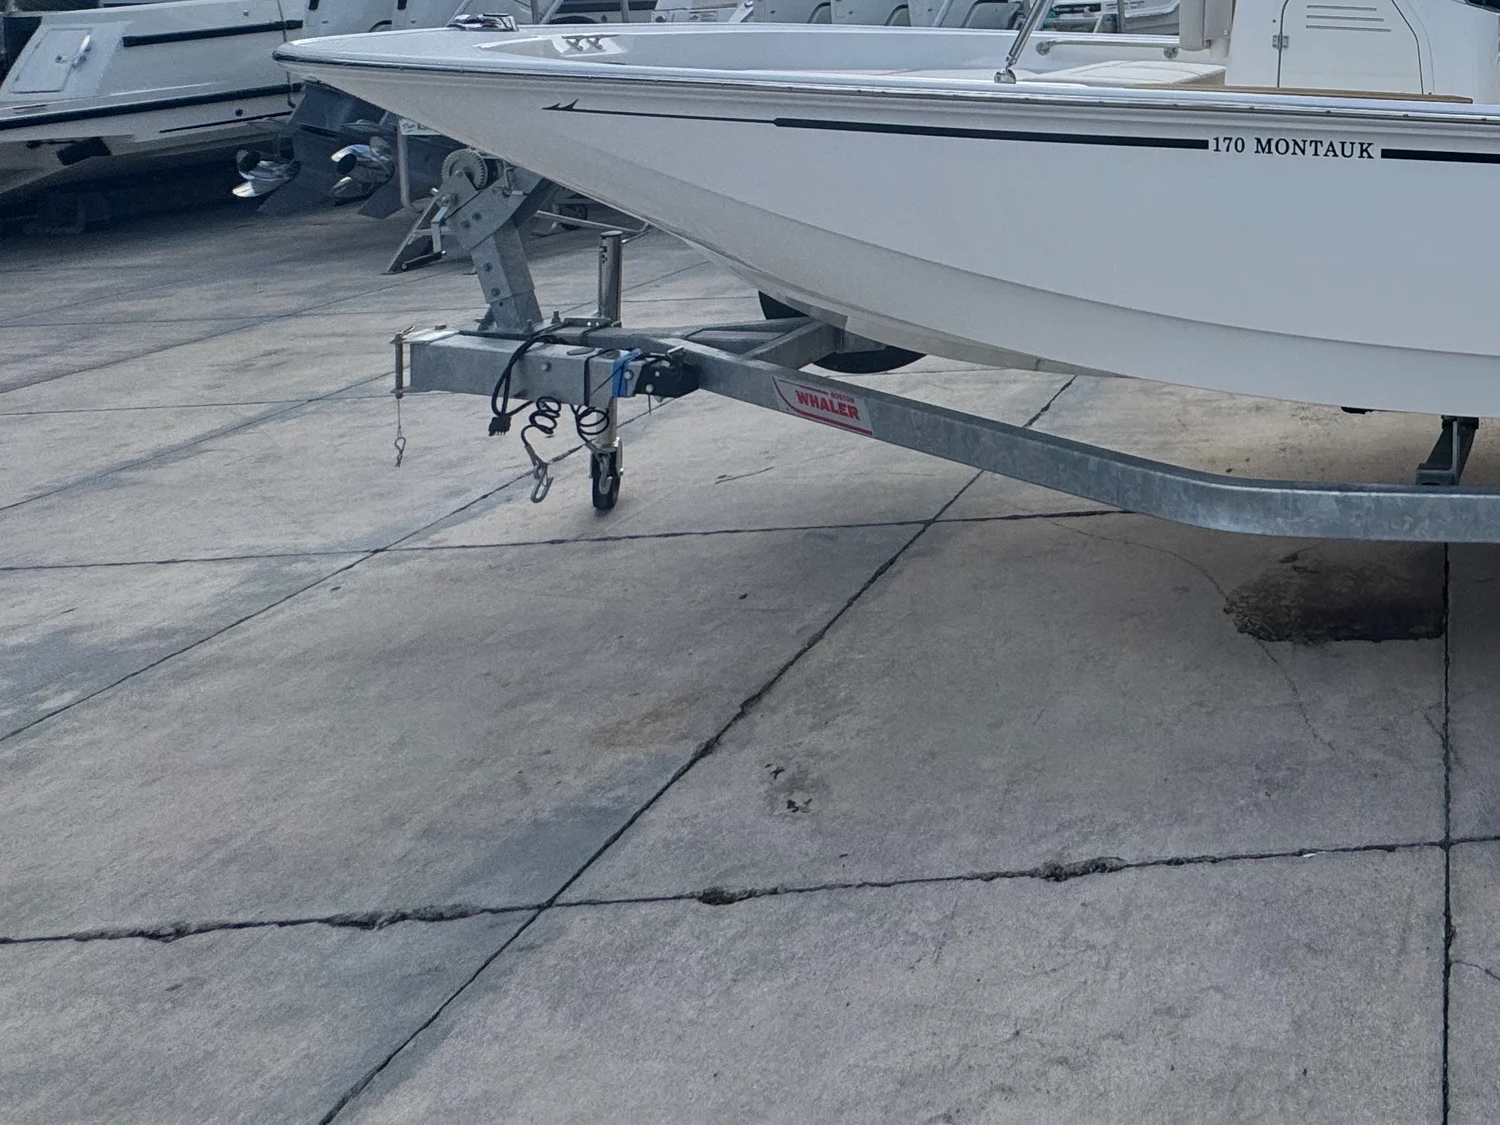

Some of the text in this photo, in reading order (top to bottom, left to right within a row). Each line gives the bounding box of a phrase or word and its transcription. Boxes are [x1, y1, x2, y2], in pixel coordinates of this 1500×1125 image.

[1213, 136, 1375, 160] 170 MONTAUK
[795, 388, 861, 421] WHALER
